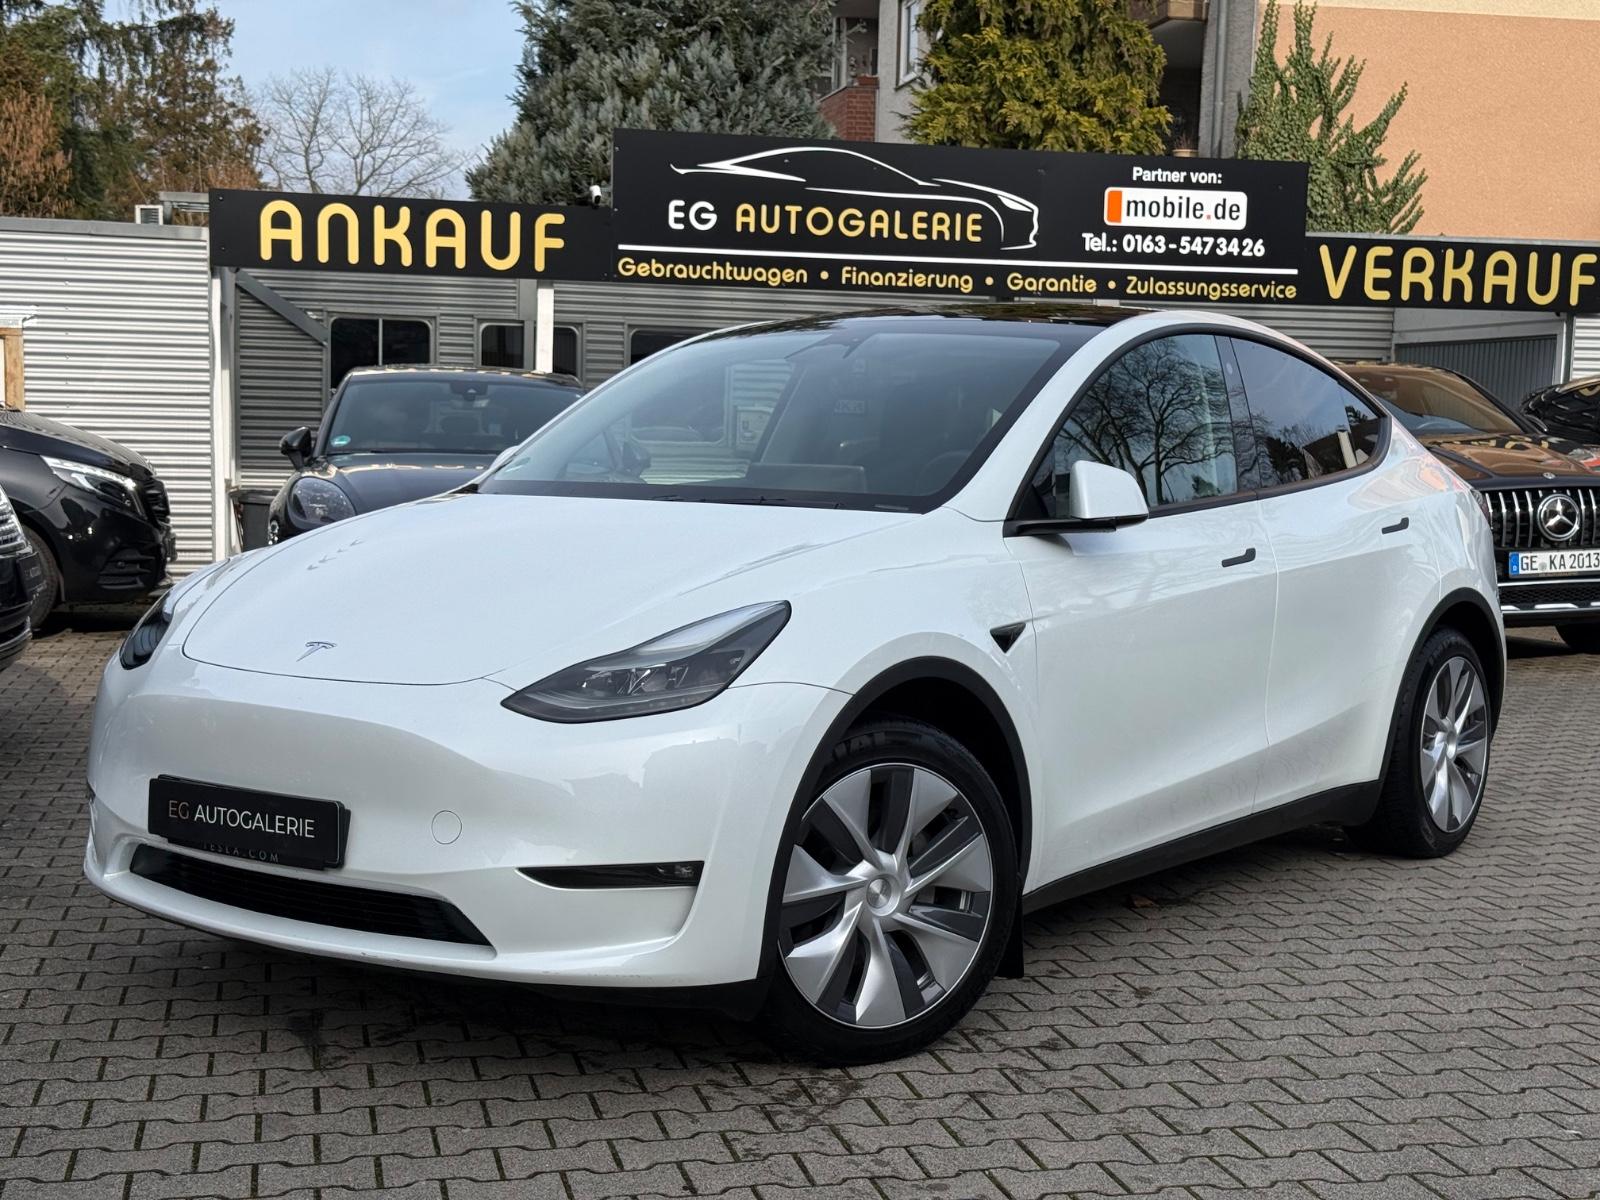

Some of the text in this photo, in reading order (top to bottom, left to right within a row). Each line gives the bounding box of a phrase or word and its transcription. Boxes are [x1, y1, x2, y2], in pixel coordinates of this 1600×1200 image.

[1132, 166, 1223, 185] Partner von:
[668, 199, 983, 243] EG AUTOGALERIE
[1126, 195, 1241, 221] mobile.de
[260, 199, 566, 273] ANKAUF
[1082, 232, 1118, 252] Tel.:
[617, 257, 1297, 300] Gebrauchtwagen Finanzierung Garantie Zulassungsservice
[1319, 244, 1599, 307] VERKAUF
[1520, 555, 1538, 571] GE
[168, 799, 315, 839] EG AUTOGALERIE
